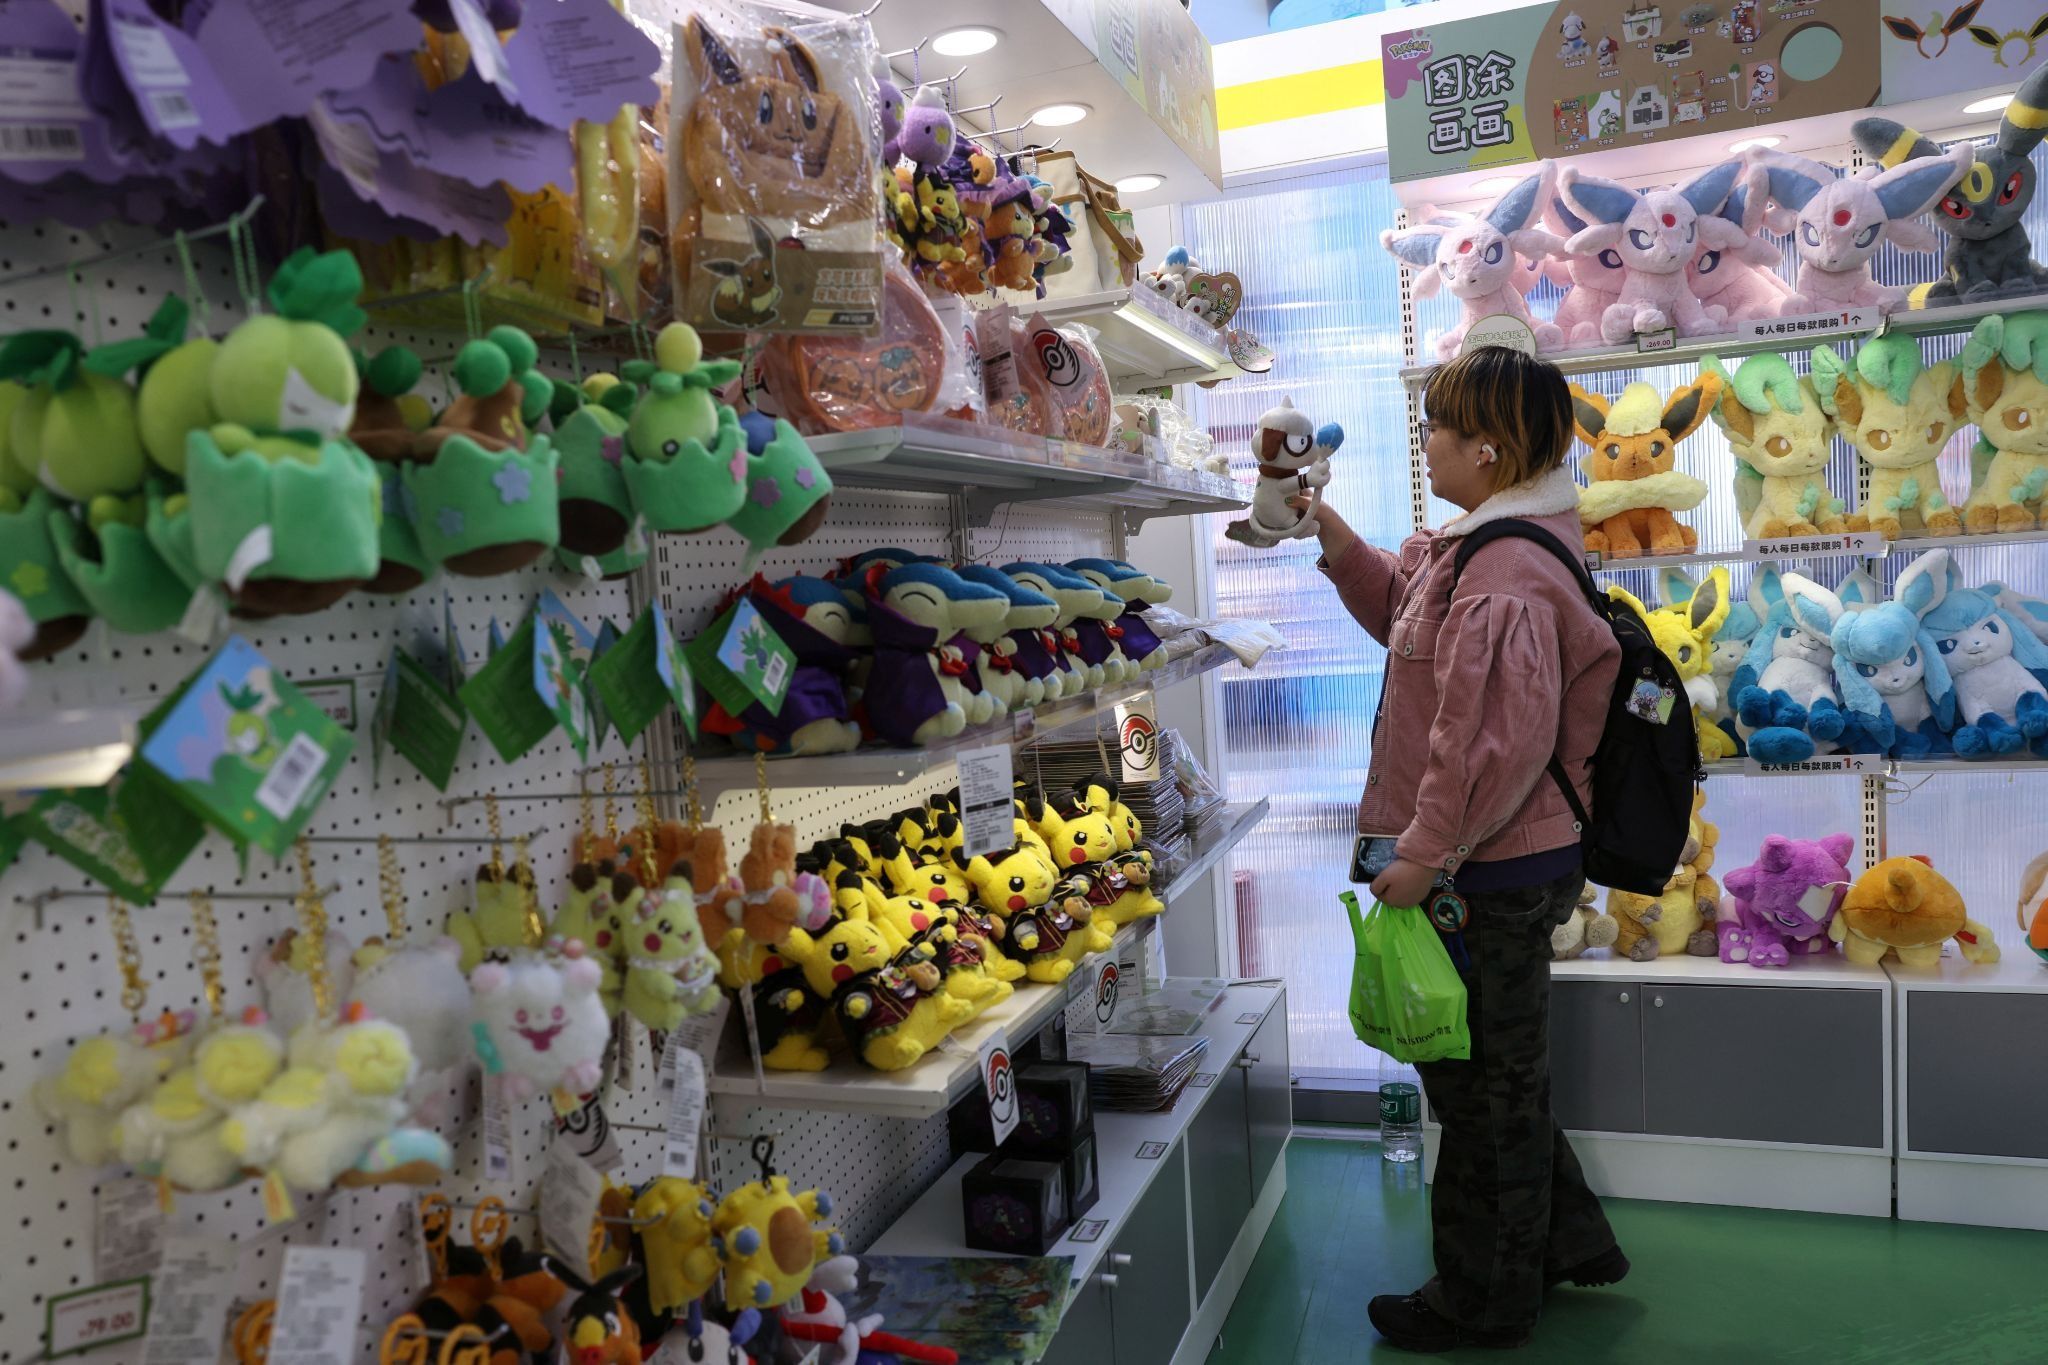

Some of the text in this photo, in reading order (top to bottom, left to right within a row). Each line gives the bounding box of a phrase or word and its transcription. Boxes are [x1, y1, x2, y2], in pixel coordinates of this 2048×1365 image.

[1428, 100, 1515, 154] 画画
[1754, 312, 1862, 336] 每人每日每款限购1个
[1758, 536, 1864, 555] 每人每日每款限购1个
[1760, 757, 1864, 772] 每人每日每款限购1个
